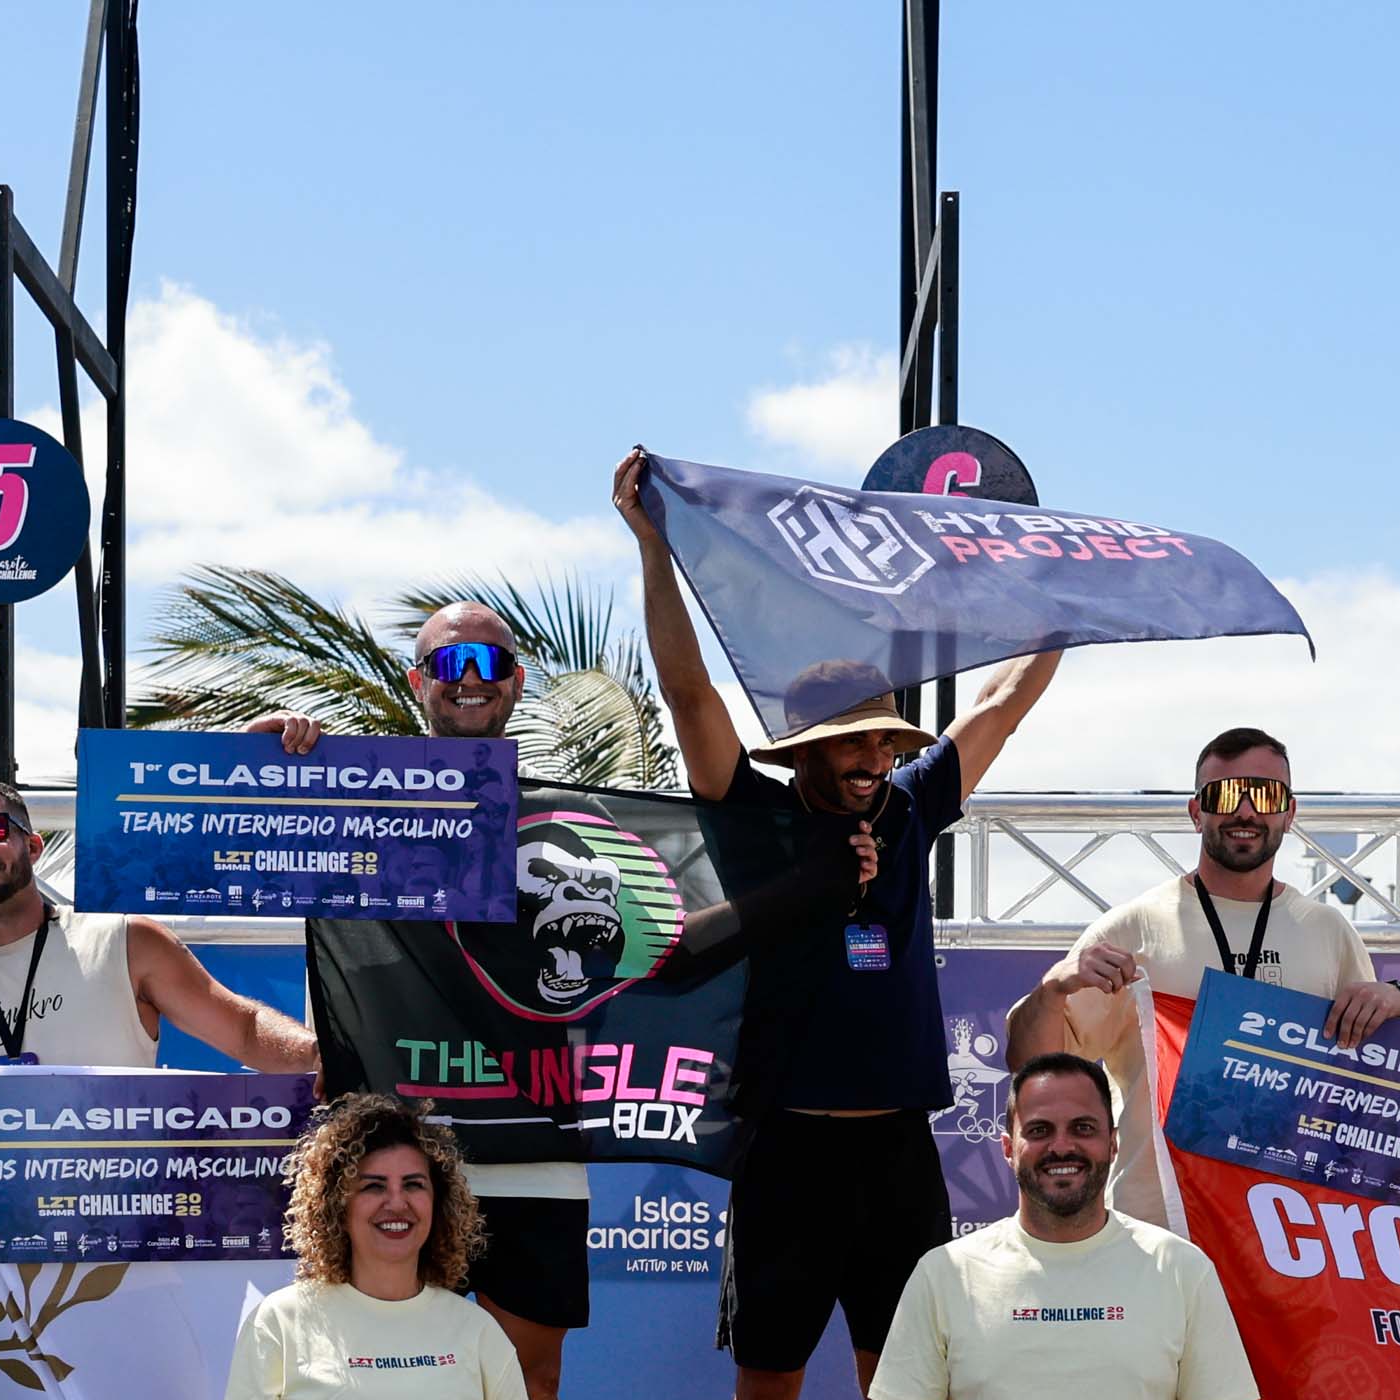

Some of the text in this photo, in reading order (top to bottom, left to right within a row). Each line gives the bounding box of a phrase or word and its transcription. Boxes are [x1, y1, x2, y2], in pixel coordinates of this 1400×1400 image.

[913, 508, 1173, 539] HYBRID
[938, 532, 1196, 564] PROJECT
[167, 762, 466, 791] CLASIFICADO
[119, 811, 473, 839] TEAMS INTERMEDIO MASCULINO
[213, 850, 253, 863] LZT
[255, 850, 349, 873] CHALLENGE
[214, 863, 251, 872] SMMR
[396, 1039, 504, 1082] THE
[1222, 1057, 1289, 1093] TEAMS
[613, 1103, 702, 1144] BOX
[1296, 1127, 1332, 1141] SMMR
[1297, 1115, 1337, 1133] LZT
[24, 1157, 159, 1182] INTERMEDIO
[38, 1196, 77, 1209] LZT
[79, 1194, 173, 1216] CHALLENGE
[38, 1209, 75, 1217] SMMR
[633, 1196, 710, 1224] Islas
[586, 1221, 711, 1251] anarias
[626, 1258, 709, 1273] LATITUD DE VIDA
[1041, 1307, 1105, 1321] CHALLENGE
[375, 1355, 437, 1369] CHALLENGE
